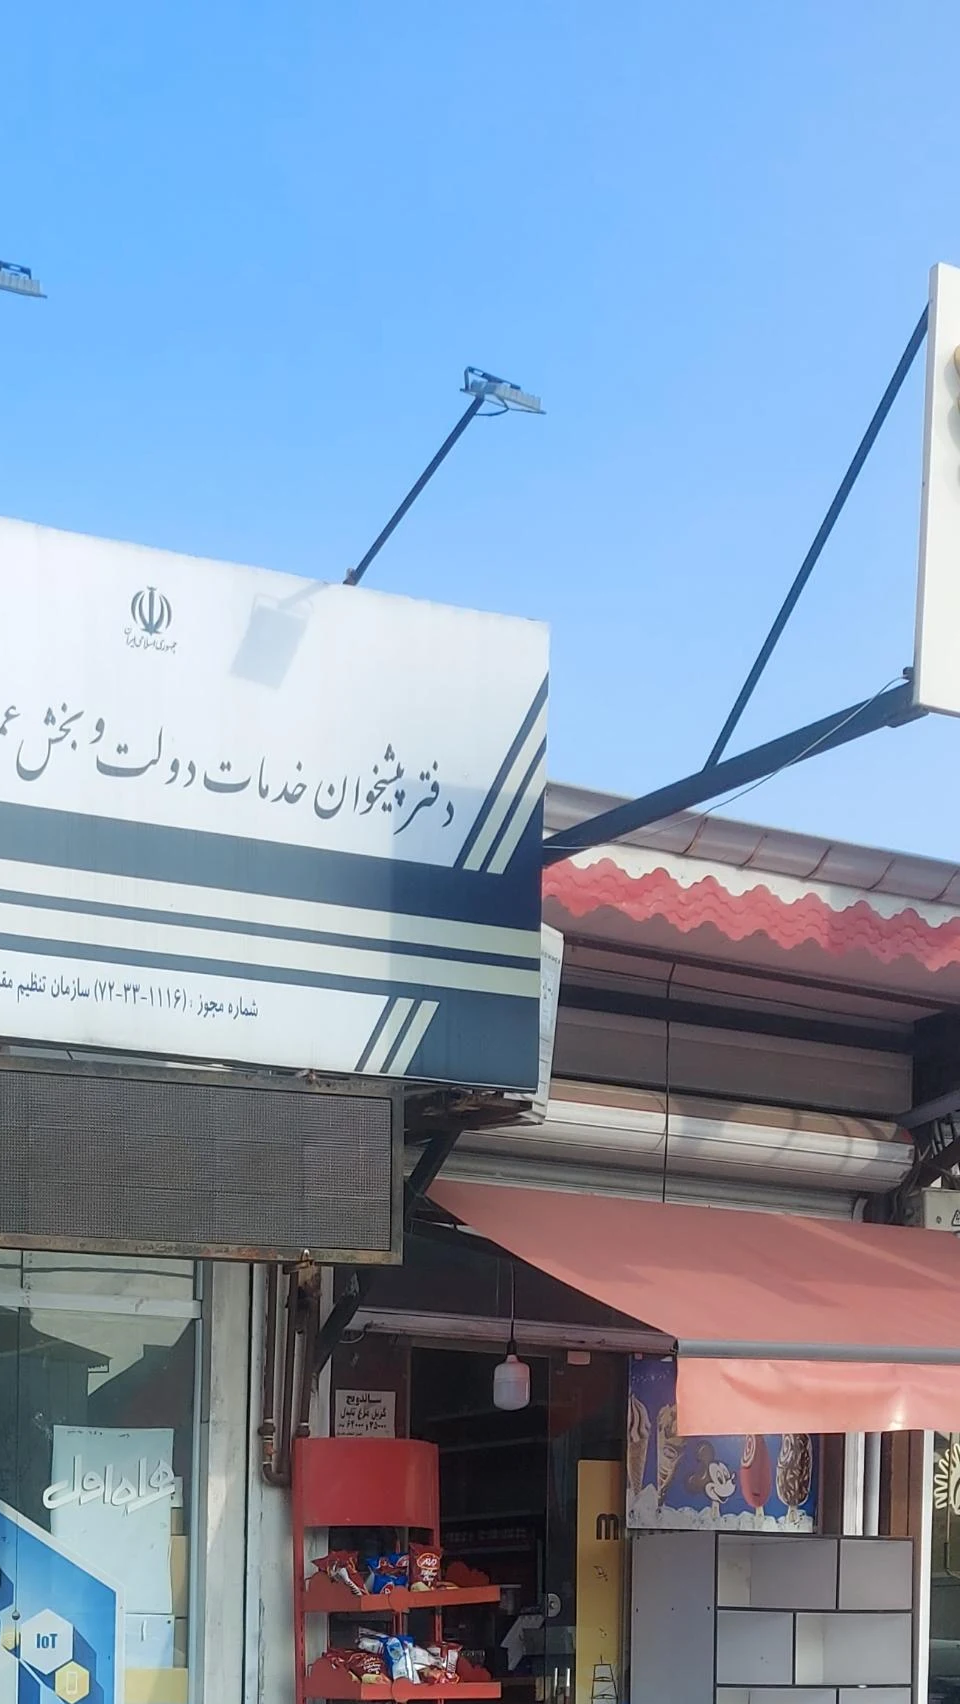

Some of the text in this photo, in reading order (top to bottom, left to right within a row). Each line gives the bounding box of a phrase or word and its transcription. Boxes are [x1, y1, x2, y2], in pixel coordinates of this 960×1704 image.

[15, 701, 86, 782] بخش
[89, 716, 106, 745] و
[95, 725, 197, 788] دولت
[203, 755, 308, 805] خدمات
[313, 742, 407, 820] پیشخوان
[393, 760, 454, 836] دفتر
[16, 971, 46, 1001] تنظیم
[50, 975, 90, 1002] سازمان
[196, 993, 224, 1019] مجوز
[227, 996, 259, 1020] شماره
[35, 1632, 58, 1650] IoT
